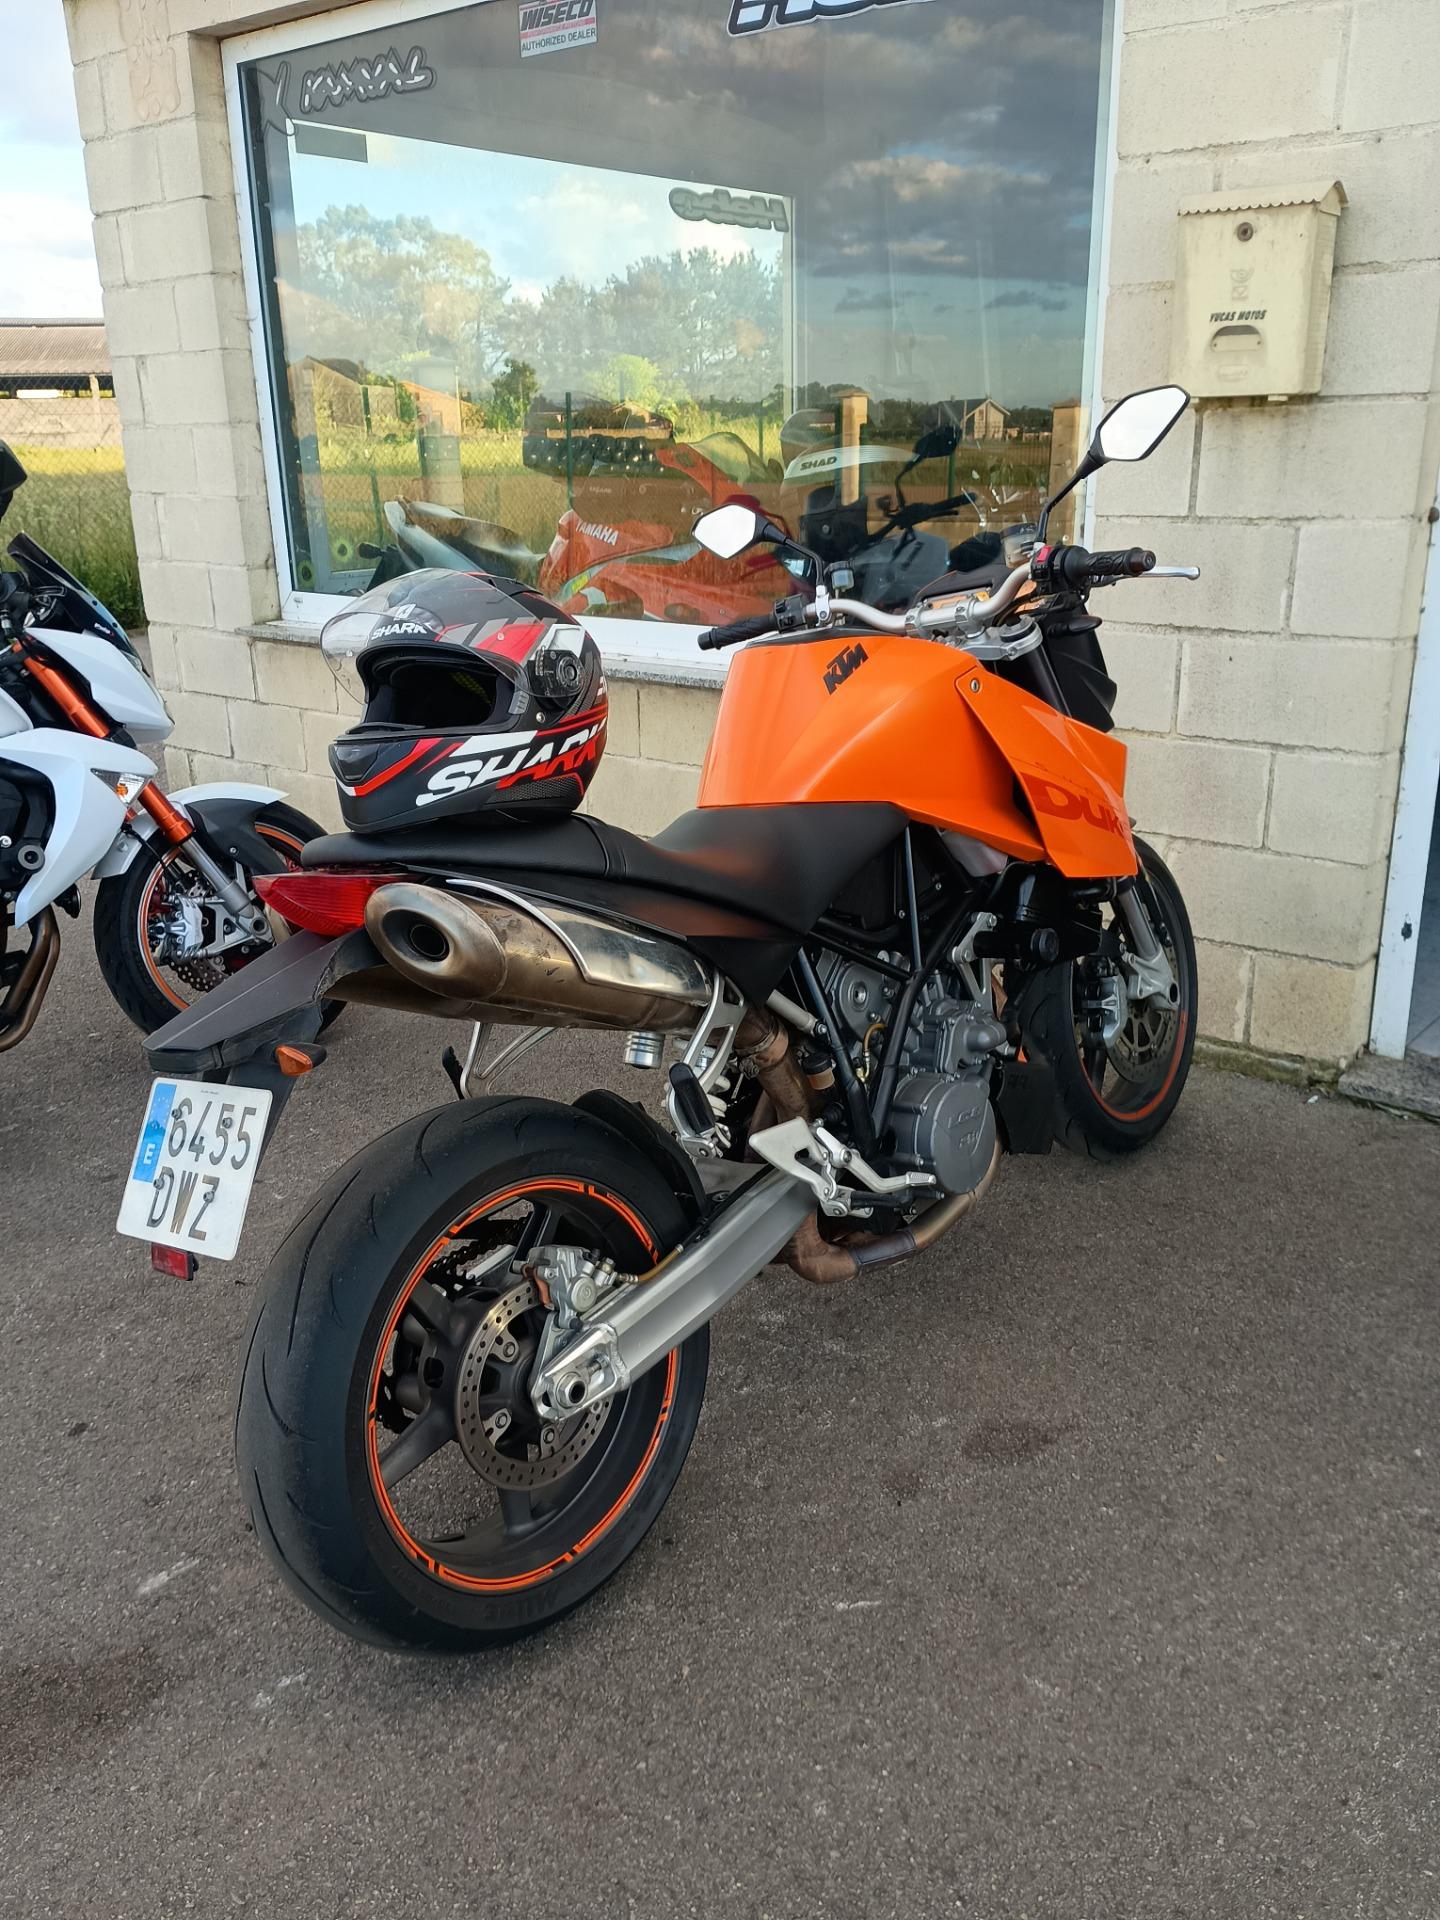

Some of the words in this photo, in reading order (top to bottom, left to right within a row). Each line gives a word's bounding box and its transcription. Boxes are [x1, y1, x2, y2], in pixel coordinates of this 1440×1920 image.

[520, 0, 595, 32] WISECO
[521, 35, 567, 52] AUTHORIZED
[567, 27, 596, 43] DEALER
[1210, 312, 1235, 322] YUCAS
[1238, 310, 1266, 320] MOTOS
[800, 456, 837, 471] SHAD
[575, 519, 619, 546] YAMAHA
[371, 621, 430, 641] SHARK
[823, 642, 869, 696] KTM
[168, 1097, 257, 1170] 6455
[143, 1143, 156, 1165] E
[146, 1166, 220, 1241] DWZ
